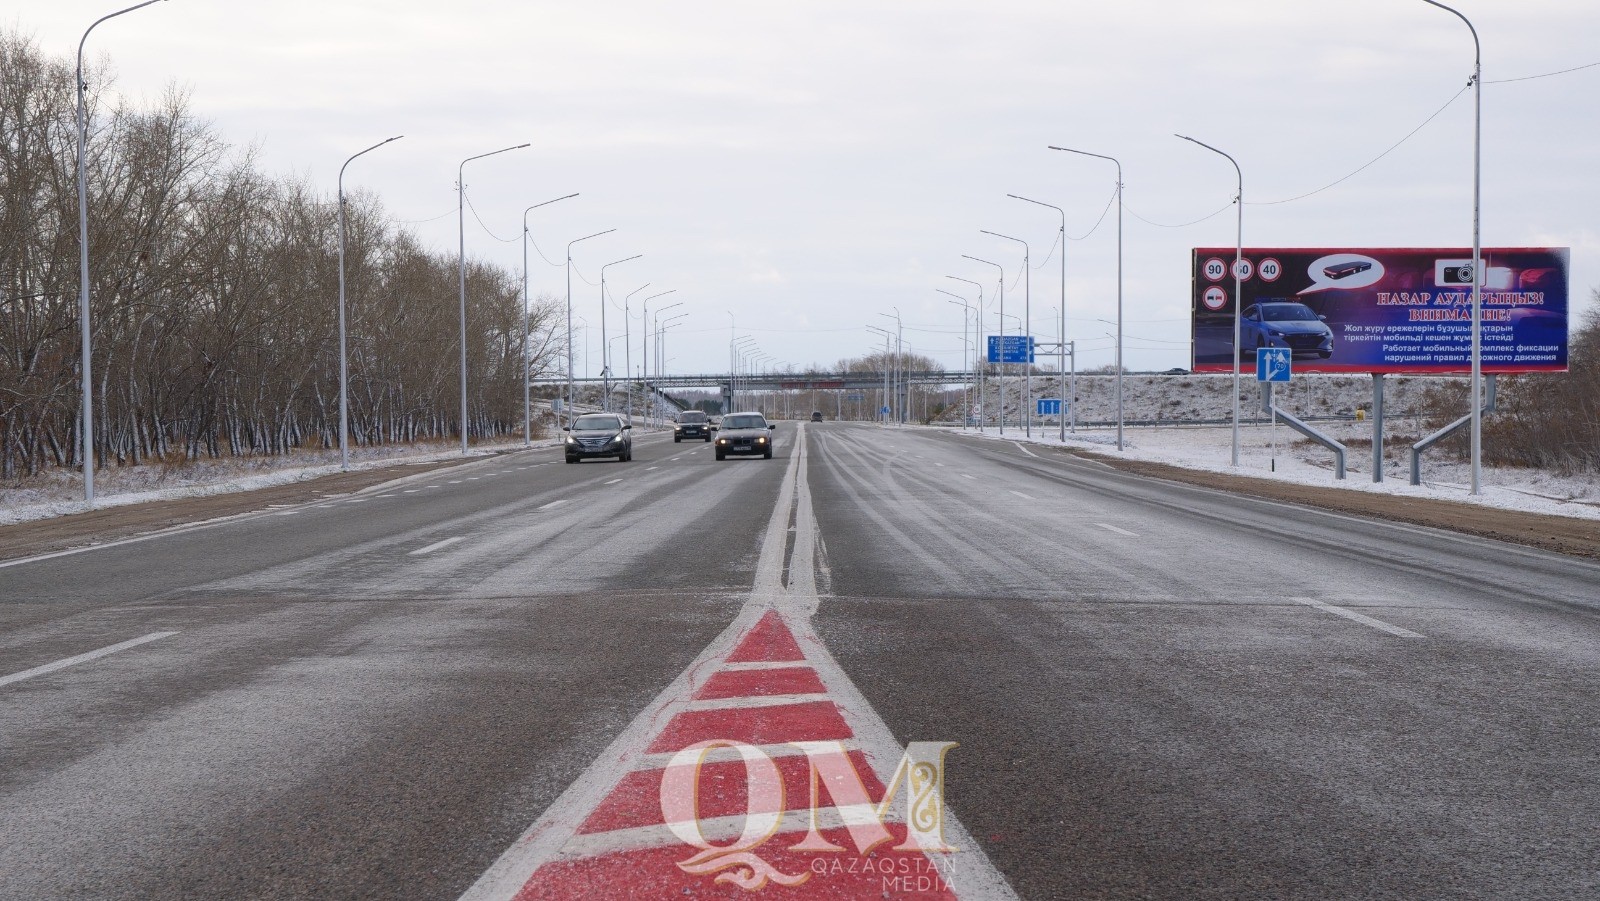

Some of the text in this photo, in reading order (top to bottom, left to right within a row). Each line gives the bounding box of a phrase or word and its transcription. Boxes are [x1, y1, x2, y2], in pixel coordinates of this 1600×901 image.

[1208, 265, 1222, 274] 90
[1263, 265, 1276, 274] 40
[1377, 292, 1431, 306] НАЗАР
[1344, 324, 1363, 332] Жол
[1364, 325, 1385, 334] жүру
[1387, 324, 1435, 334] ережелерін
[1344, 334, 1381, 343] тіркейтін
[1383, 334, 1424, 342] мобильді
[1484, 334, 1514, 342] істейді
[1383, 344, 1421, 352] Работает
[1423, 344, 1473, 352] мобильный
[1516, 344, 1559, 353] фиксации
[1385, 353, 1431, 362] нарушений
